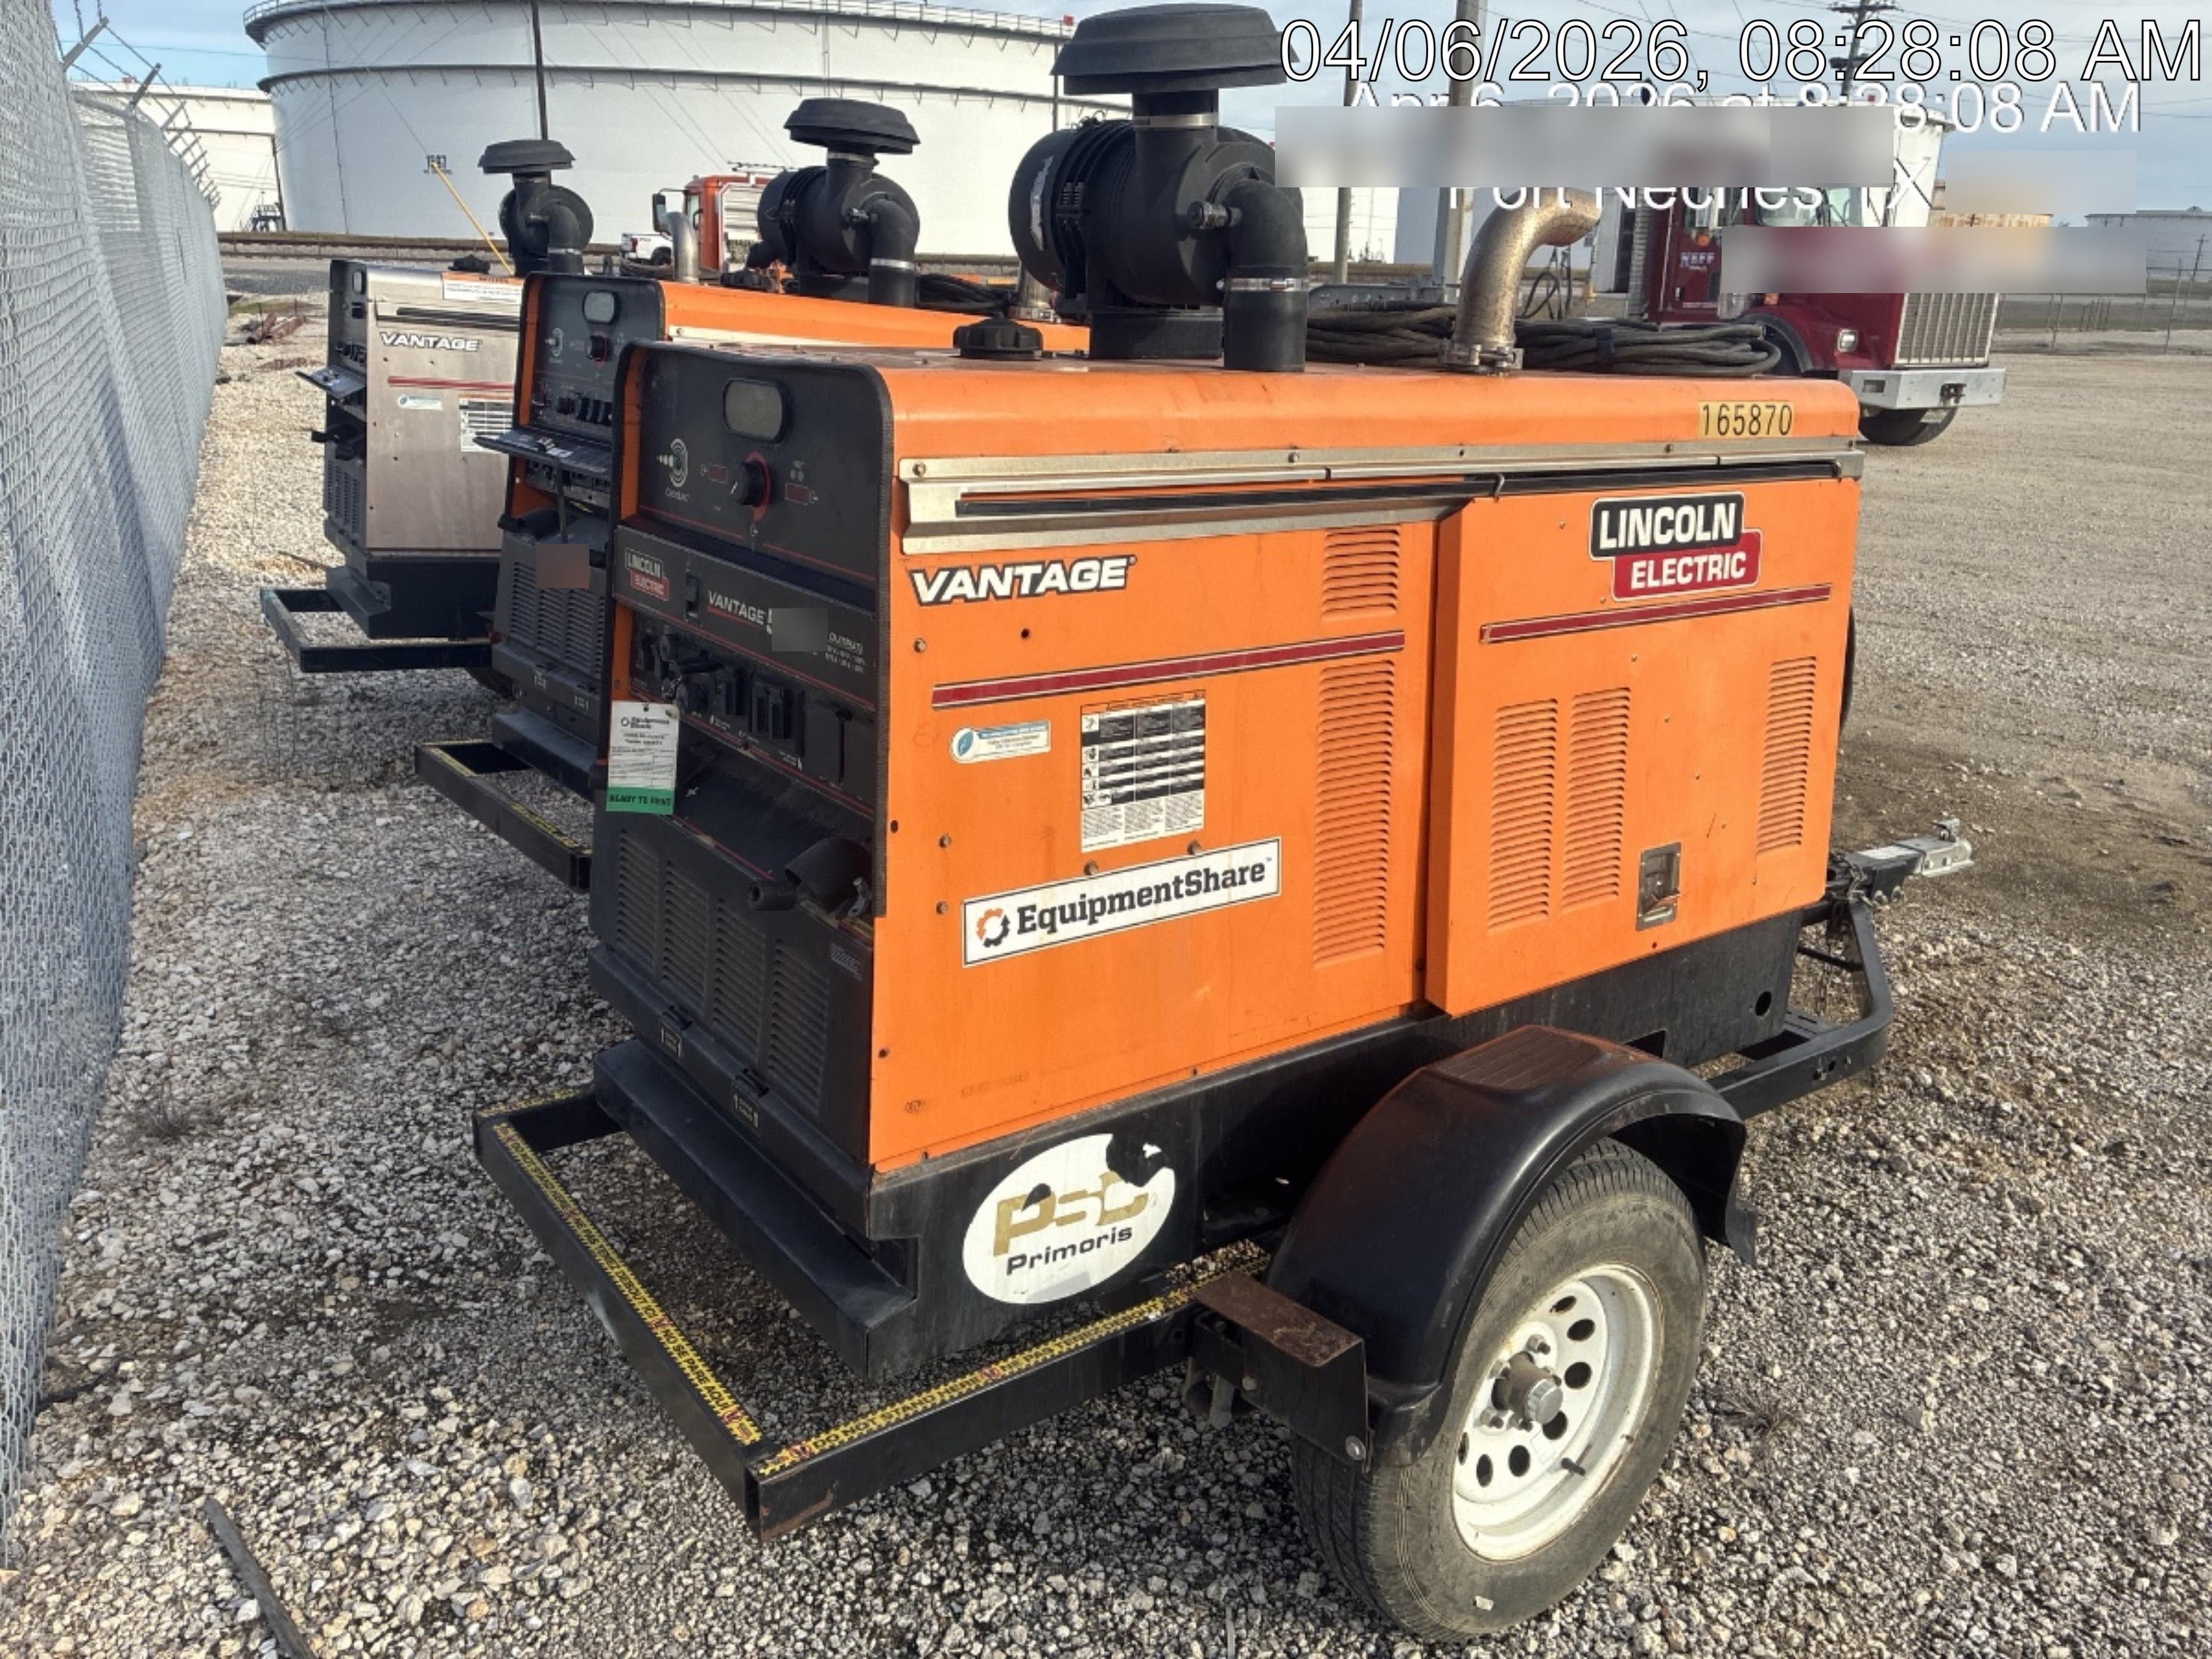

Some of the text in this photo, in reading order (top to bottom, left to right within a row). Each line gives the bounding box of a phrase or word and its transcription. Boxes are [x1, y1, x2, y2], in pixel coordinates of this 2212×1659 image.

[380, 332, 480, 352] VANTAGE
[1703, 402, 1793, 436] 165870
[1599, 503, 1736, 550] LINCOLN
[629, 552, 661, 578] LINCOLN
[910, 558, 1129, 606] VANTAGE
[1630, 552, 1746, 590] ELECTRIC
[707, 590, 765, 626] VANTAGE
[1016, 861, 1266, 936] EquipmentShare
[1006, 1226, 1133, 1276] Primoris
